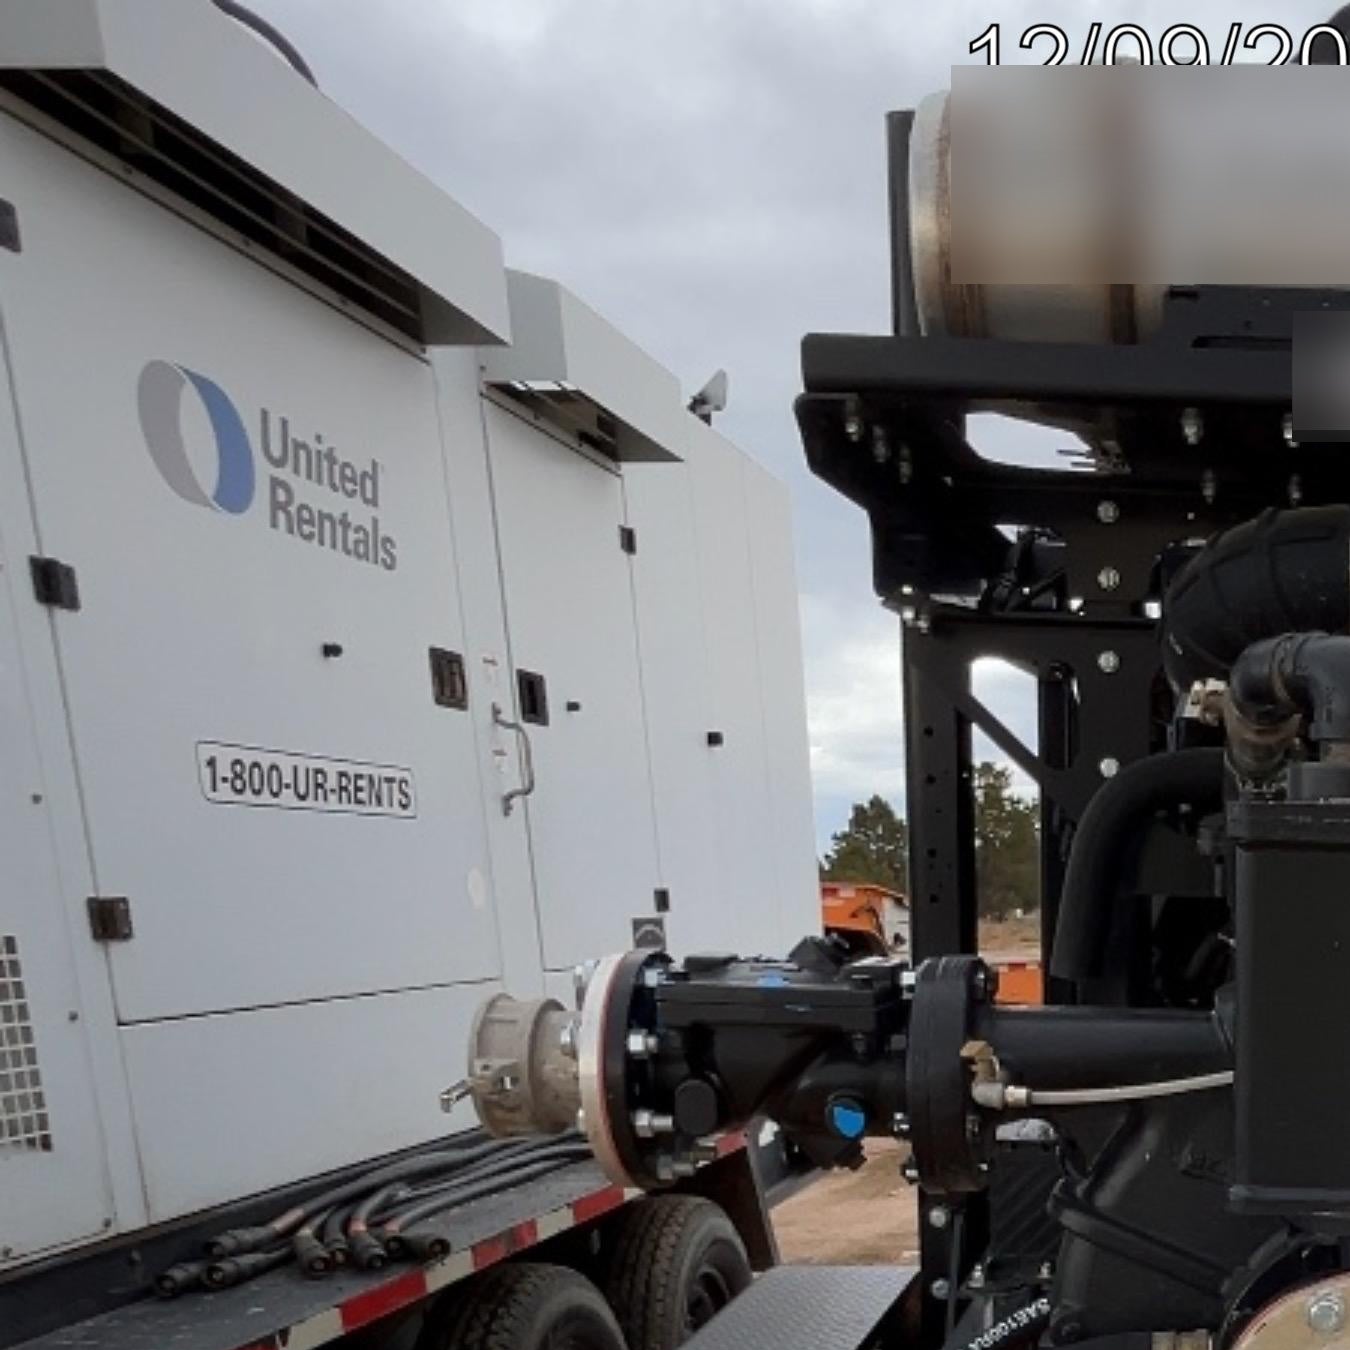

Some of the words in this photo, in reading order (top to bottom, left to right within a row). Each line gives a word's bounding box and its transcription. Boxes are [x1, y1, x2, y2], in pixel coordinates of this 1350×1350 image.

[260, 407, 380, 508] United
[269, 474, 398, 571] Rentals
[206, 755, 411, 810] 1-800-UR-RENTS
